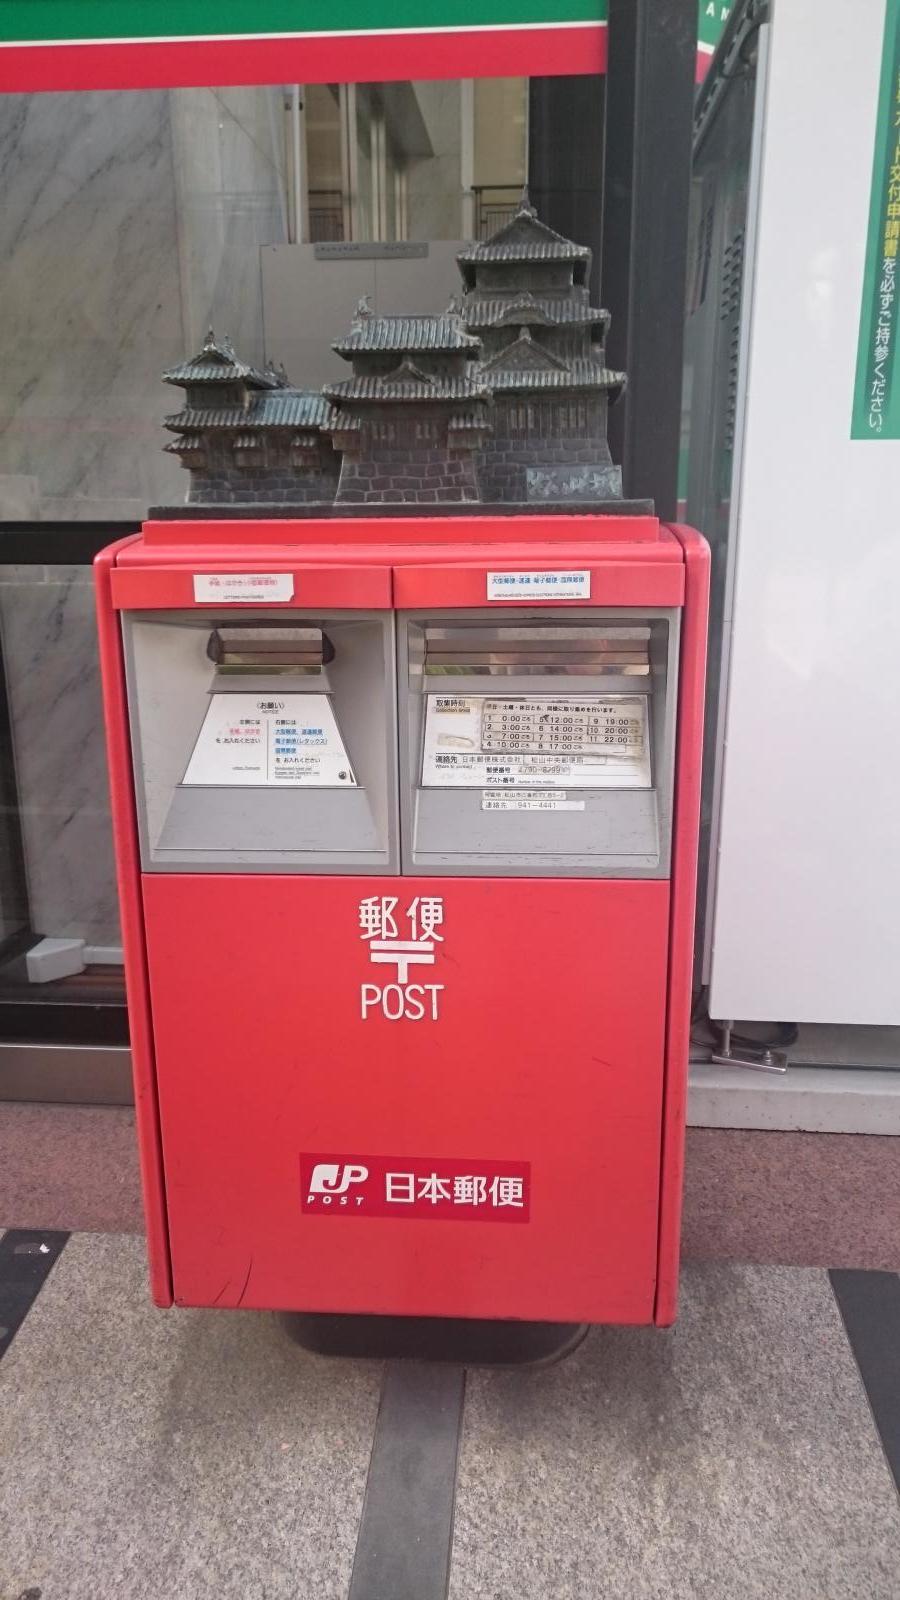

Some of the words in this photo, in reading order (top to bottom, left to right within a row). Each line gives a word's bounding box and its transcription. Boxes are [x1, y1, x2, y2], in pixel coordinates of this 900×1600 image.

[358, 895, 444, 942] 郵便
[360, 983, 445, 1021] POST
[307, 1195, 365, 1206] POST
[385, 1172, 524, 1208] 日本郵便
